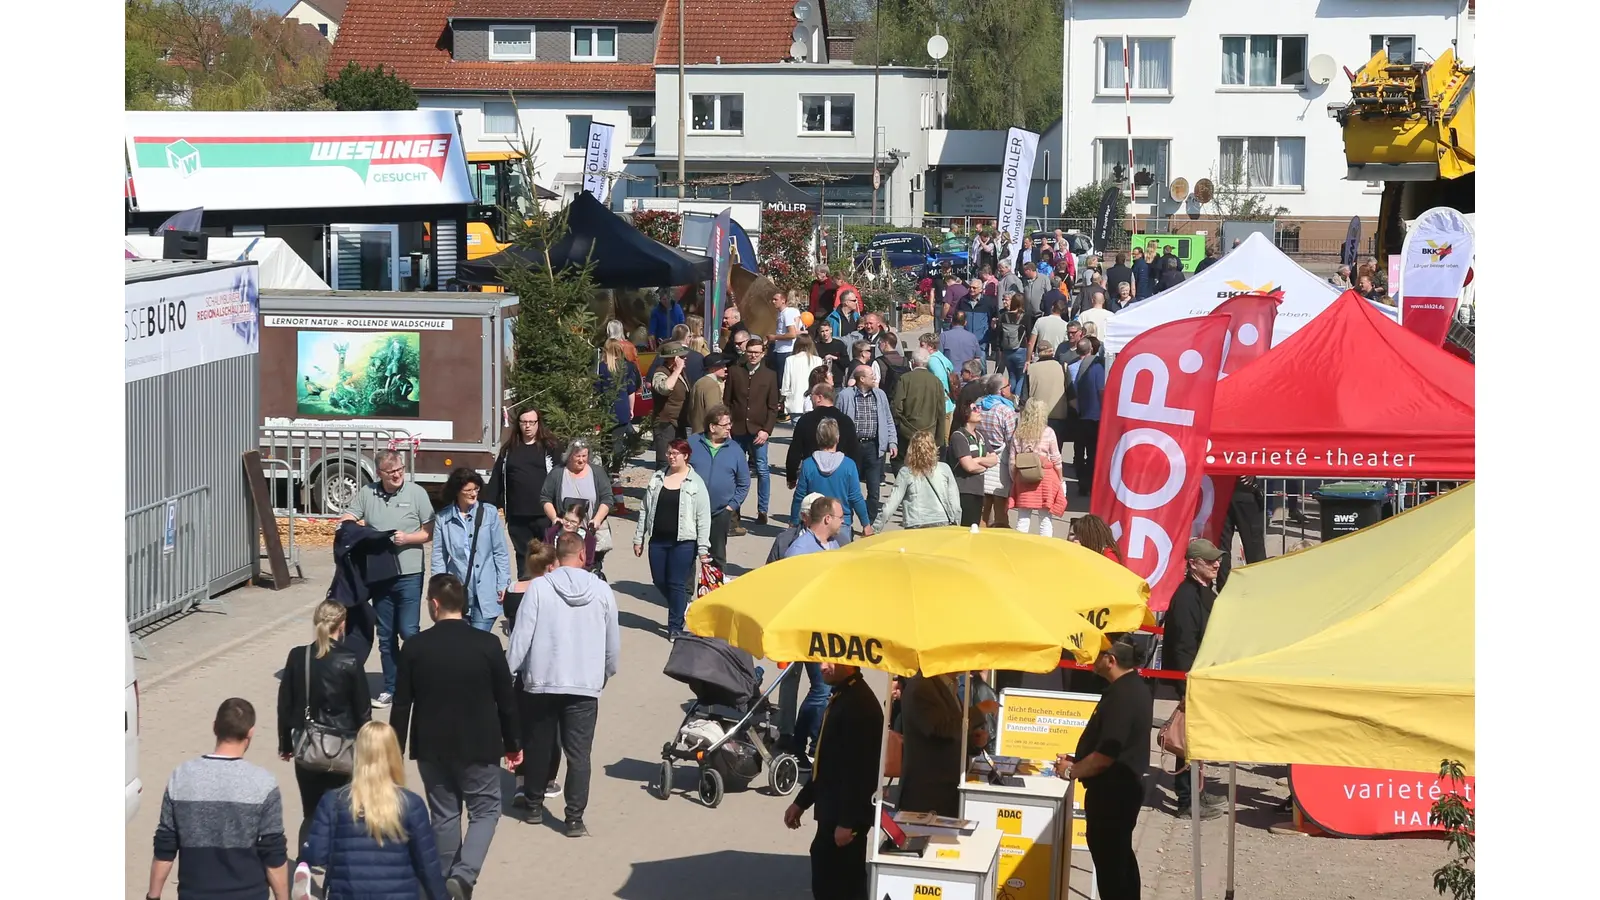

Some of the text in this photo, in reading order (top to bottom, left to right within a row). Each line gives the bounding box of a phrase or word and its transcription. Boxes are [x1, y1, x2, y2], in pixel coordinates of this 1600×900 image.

[309, 139, 448, 161] WESLINGE
[373, 171, 428, 183] GESUCHT
[1001, 137, 1022, 237] ARCEL MÖLLER
[768, 202, 807, 213] MÖLLER
[1012, 208, 1023, 245] Wunstorf
[272, 318, 308, 326] LERNORT
[311, 318, 338, 326] NATUR
[347, 319, 389, 327] ROLLENDE
[391, 320, 445, 328] WALDSCHULE
[808, 631, 883, 664] ADAC
[1027, 707, 1055, 716] fluchen,
[1007, 714, 1018, 722] die
[1007, 723, 1068, 734] Pannenhilfe rufen
[998, 809, 1022, 820] ADAC
[914, 885, 942, 897] ADAC
